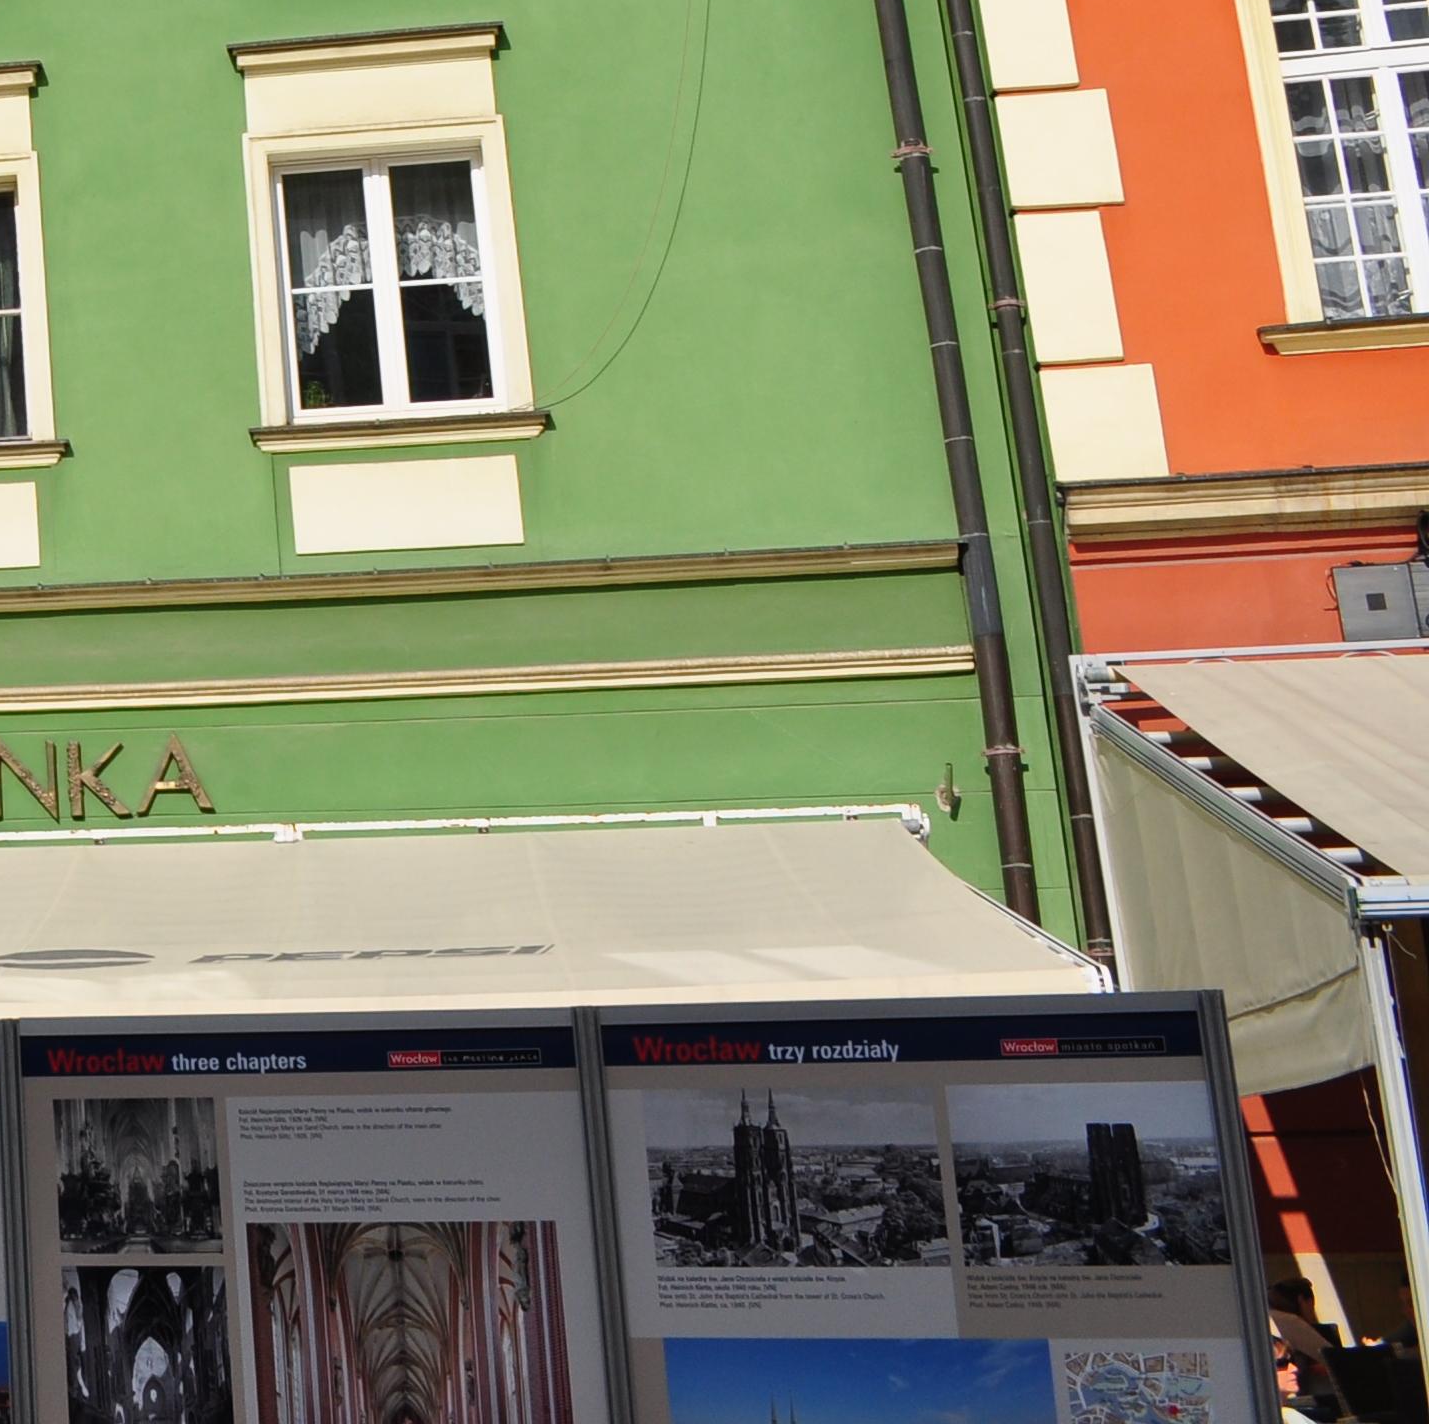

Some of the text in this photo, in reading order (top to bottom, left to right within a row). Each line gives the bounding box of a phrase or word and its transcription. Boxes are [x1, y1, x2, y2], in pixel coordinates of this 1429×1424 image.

[189, 943, 555, 964] PEPSI
[632, 1035, 899, 1064] Wrocław trzy rozdziały
[1003, 1039, 1055, 1052] Wrocław
[47, 1048, 307, 1074] Wrocław three chapters
[390, 1051, 438, 1064] Wrocław
